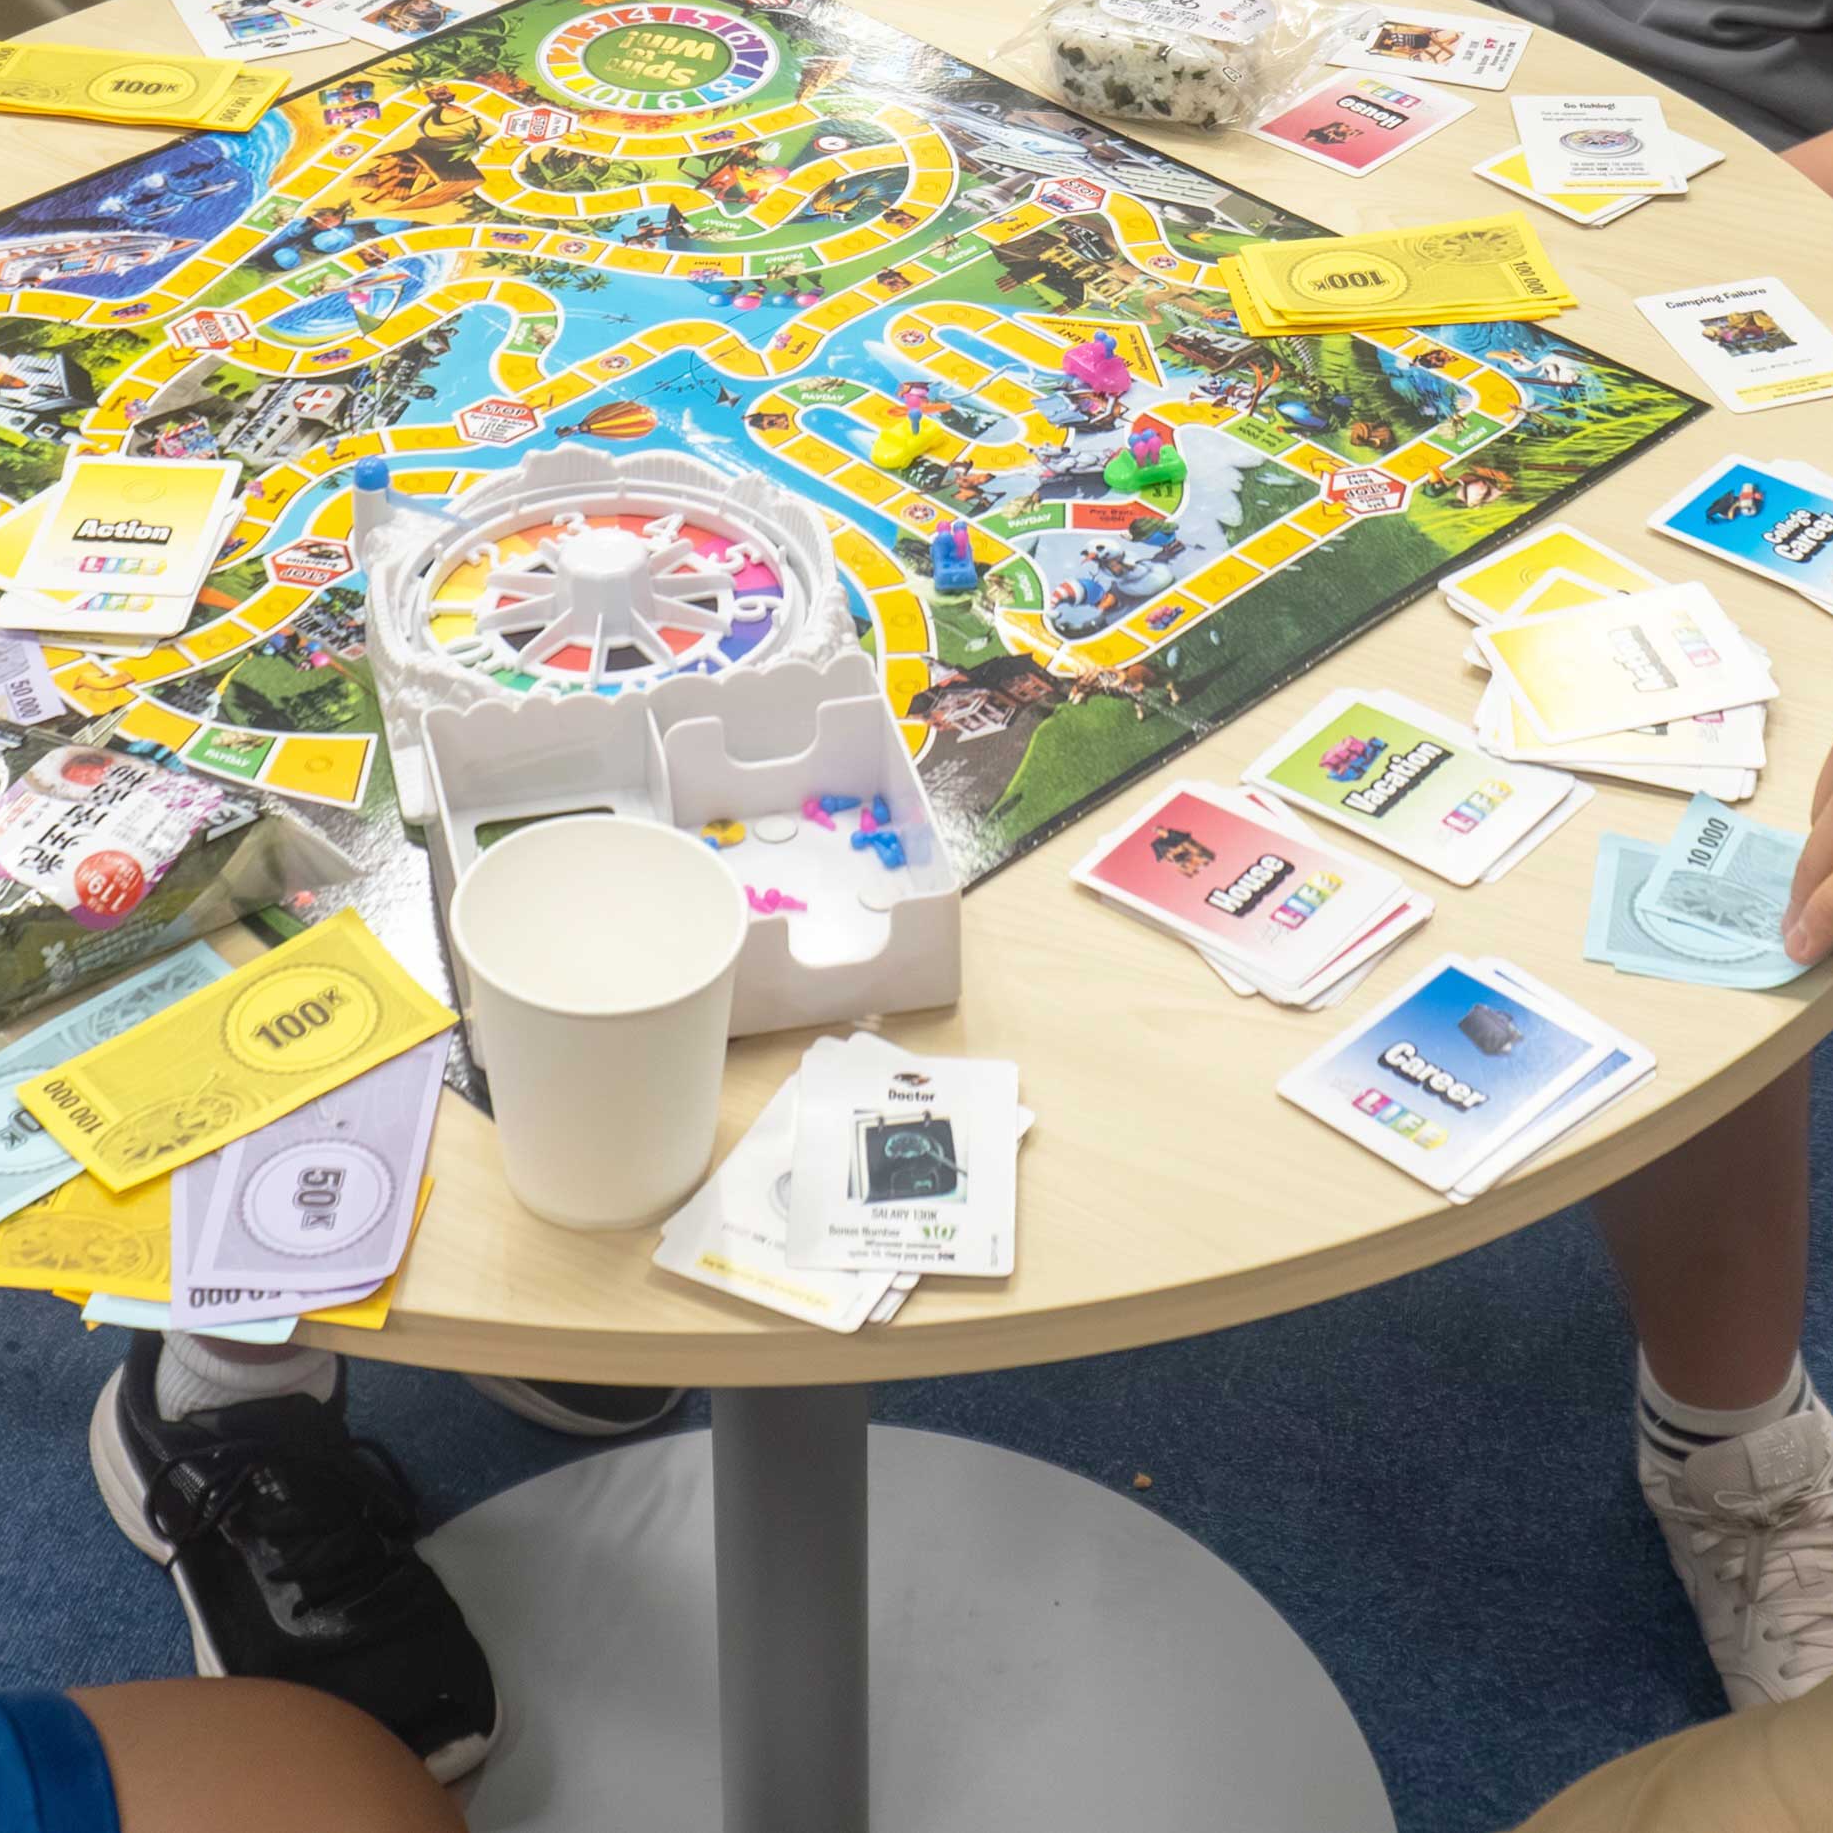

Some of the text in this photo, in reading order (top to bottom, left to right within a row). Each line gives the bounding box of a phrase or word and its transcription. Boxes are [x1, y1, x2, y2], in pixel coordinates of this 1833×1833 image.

[109, 78, 183, 97] 100K
[1337, 95, 1408, 130] House
[1063, 180, 1101, 198] STOP
[1309, 270, 1386, 290] 100K
[1665, 288, 1767, 310] Camping Failure
[800, 392, 846, 403] PAYDAY
[481, 403, 526, 417] STOP
[1345, 483, 1391, 499] STOP
[75, 519, 172, 544] Action
[1007, 513, 1052, 529] PAYDAY
[1763, 507, 1813, 545] College
[79, 556, 165, 575] LIFE
[280, 567, 330, 582] STOP
[202, 747, 251, 768] PAYDAY
[1345, 742, 1447, 816] Vacation
[1687, 816, 1730, 868] 10 000
[1209, 853, 1291, 917] House
[1271, 870, 1344, 932] LIFE
[254, 985, 349, 1050] 100K
[1382, 1041, 1488, 1110] Career
[888, 1088, 936, 1103] Doctor
[42, 1078, 104, 1136] 100 000
[293, 1167, 347, 1231] 50K
